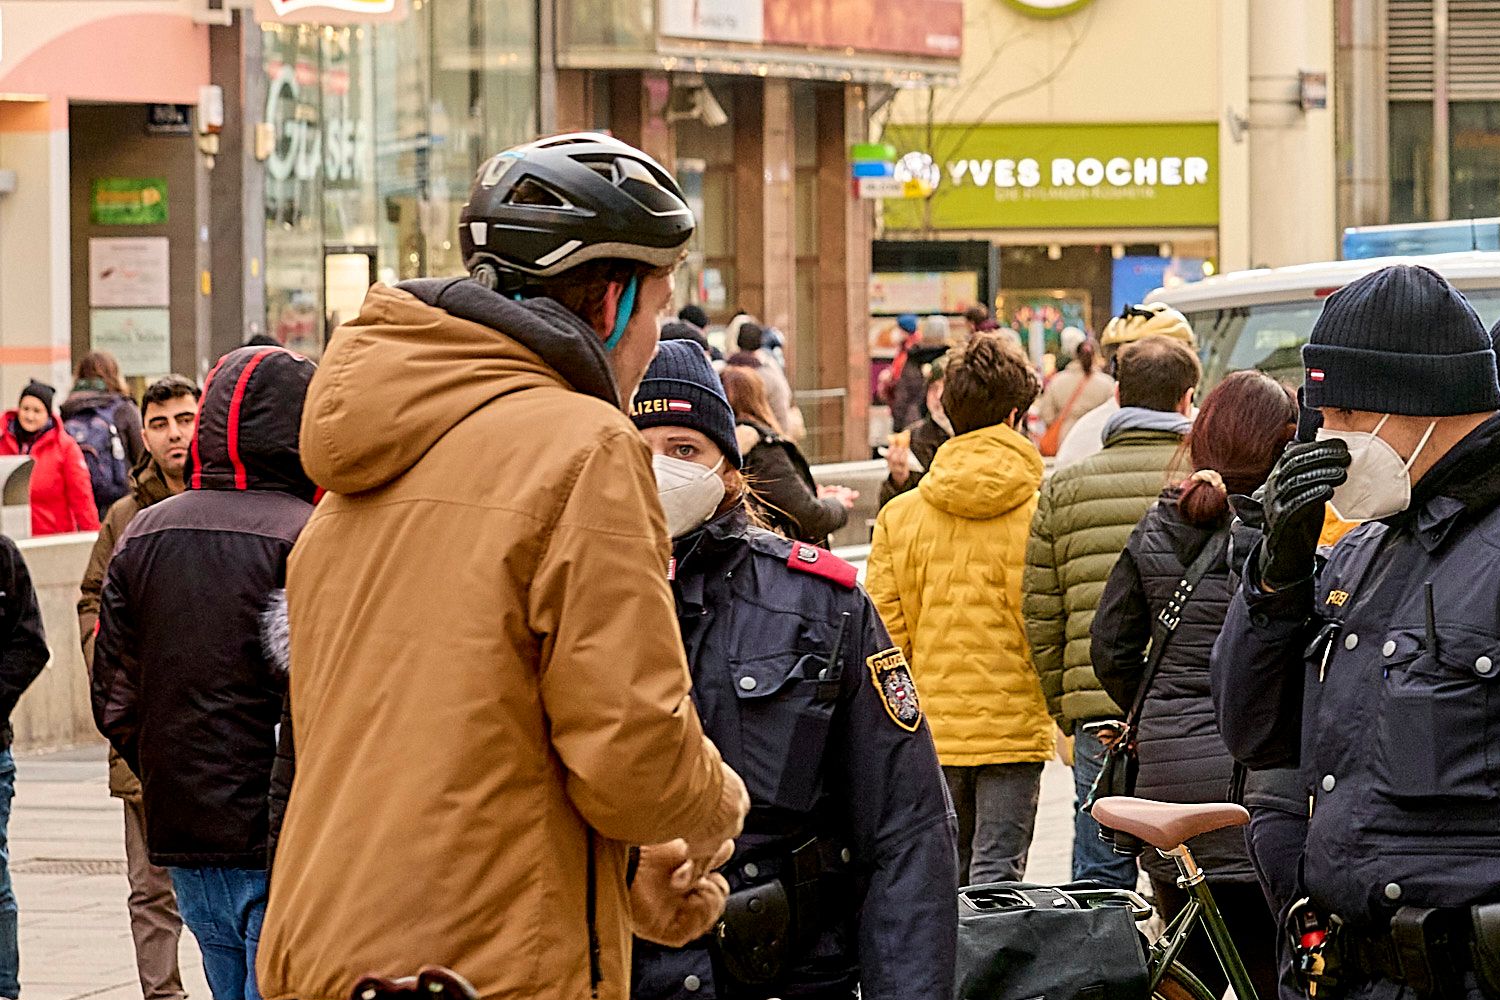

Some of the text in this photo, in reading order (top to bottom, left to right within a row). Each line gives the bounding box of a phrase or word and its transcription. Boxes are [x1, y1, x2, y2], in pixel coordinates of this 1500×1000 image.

[947, 156, 1209, 188] YVES ROCHER
[629, 398, 669, 416] LIZEI
